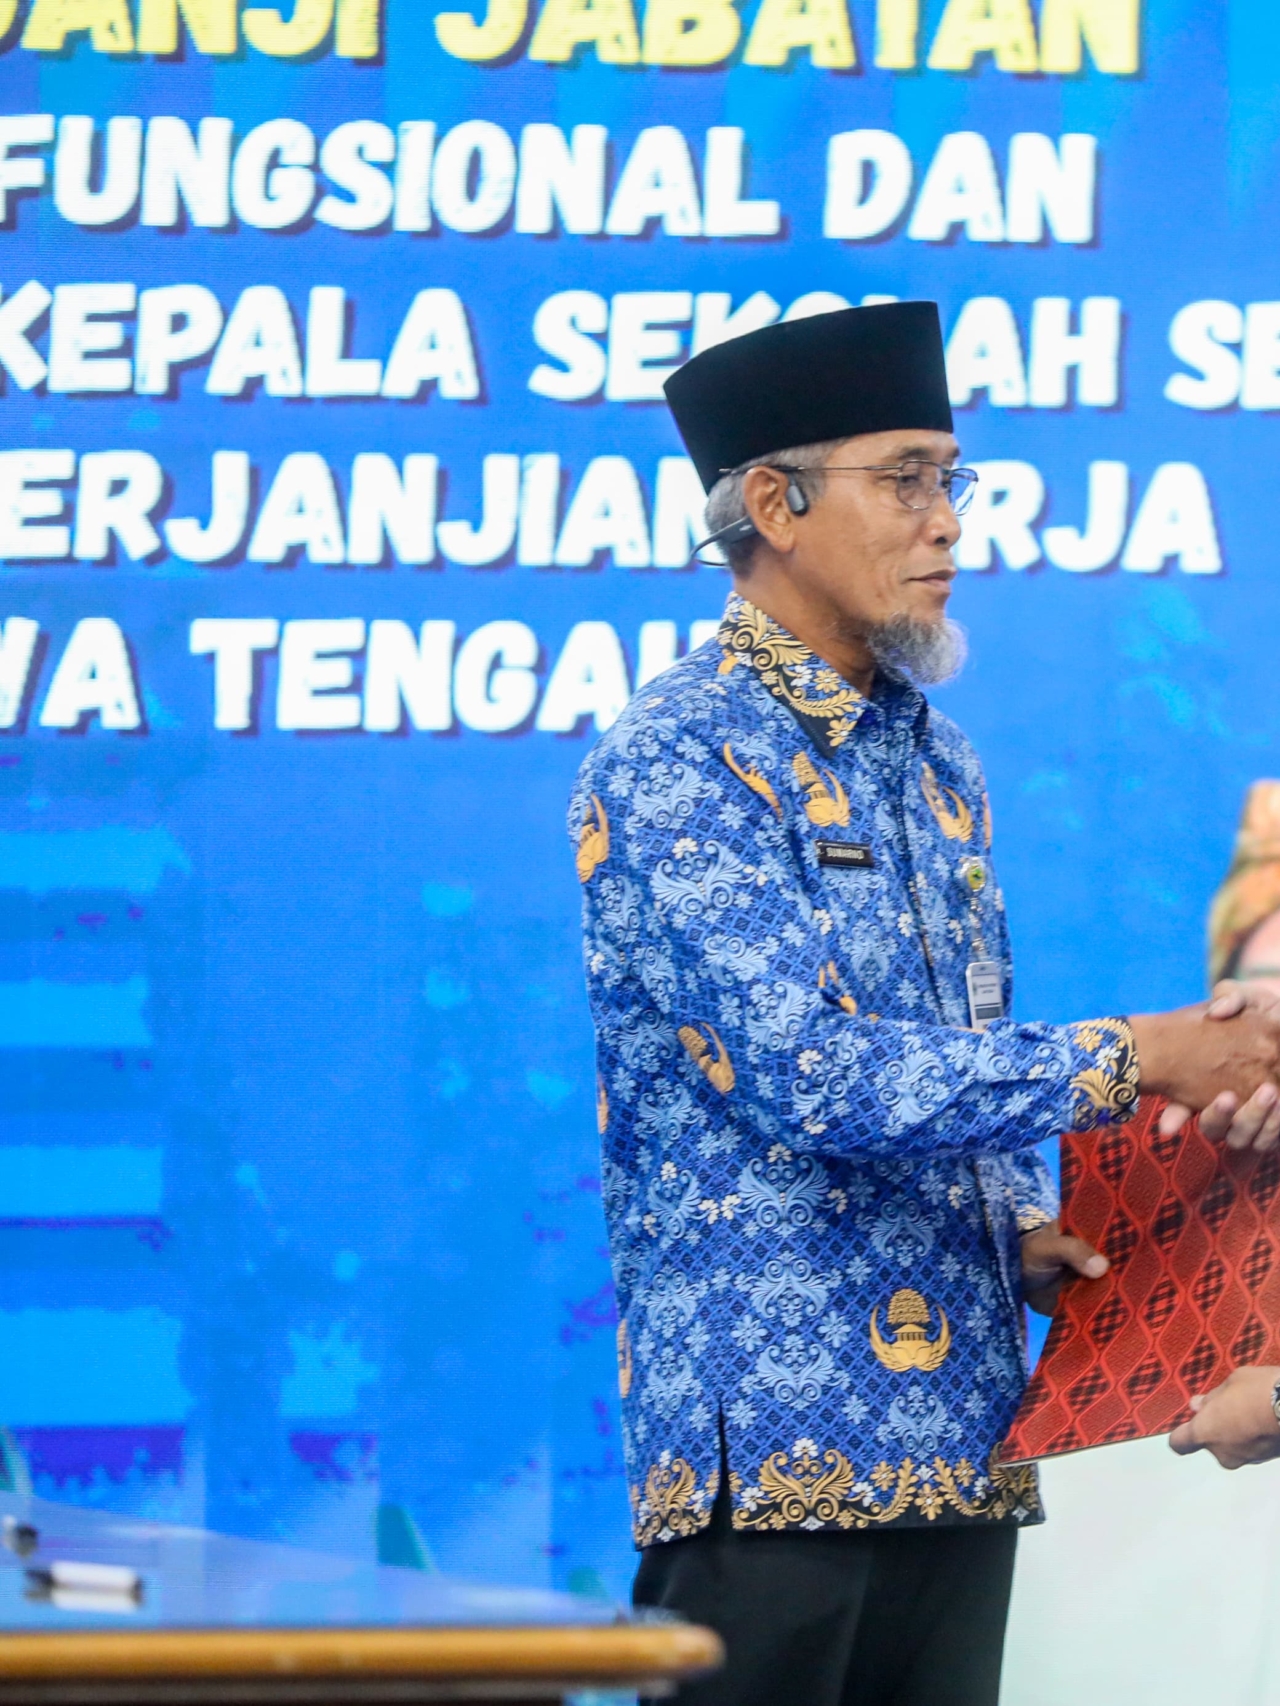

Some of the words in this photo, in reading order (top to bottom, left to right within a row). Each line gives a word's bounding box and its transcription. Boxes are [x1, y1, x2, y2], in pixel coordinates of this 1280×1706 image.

[0, 113, 781, 237] FUNGSIONAL
[822, 128, 1097, 244] DAN
[0, 279, 480, 399] KEPALA
[528, 289, 1122, 409] SEAH
[952, 459, 1224, 575] RJA
